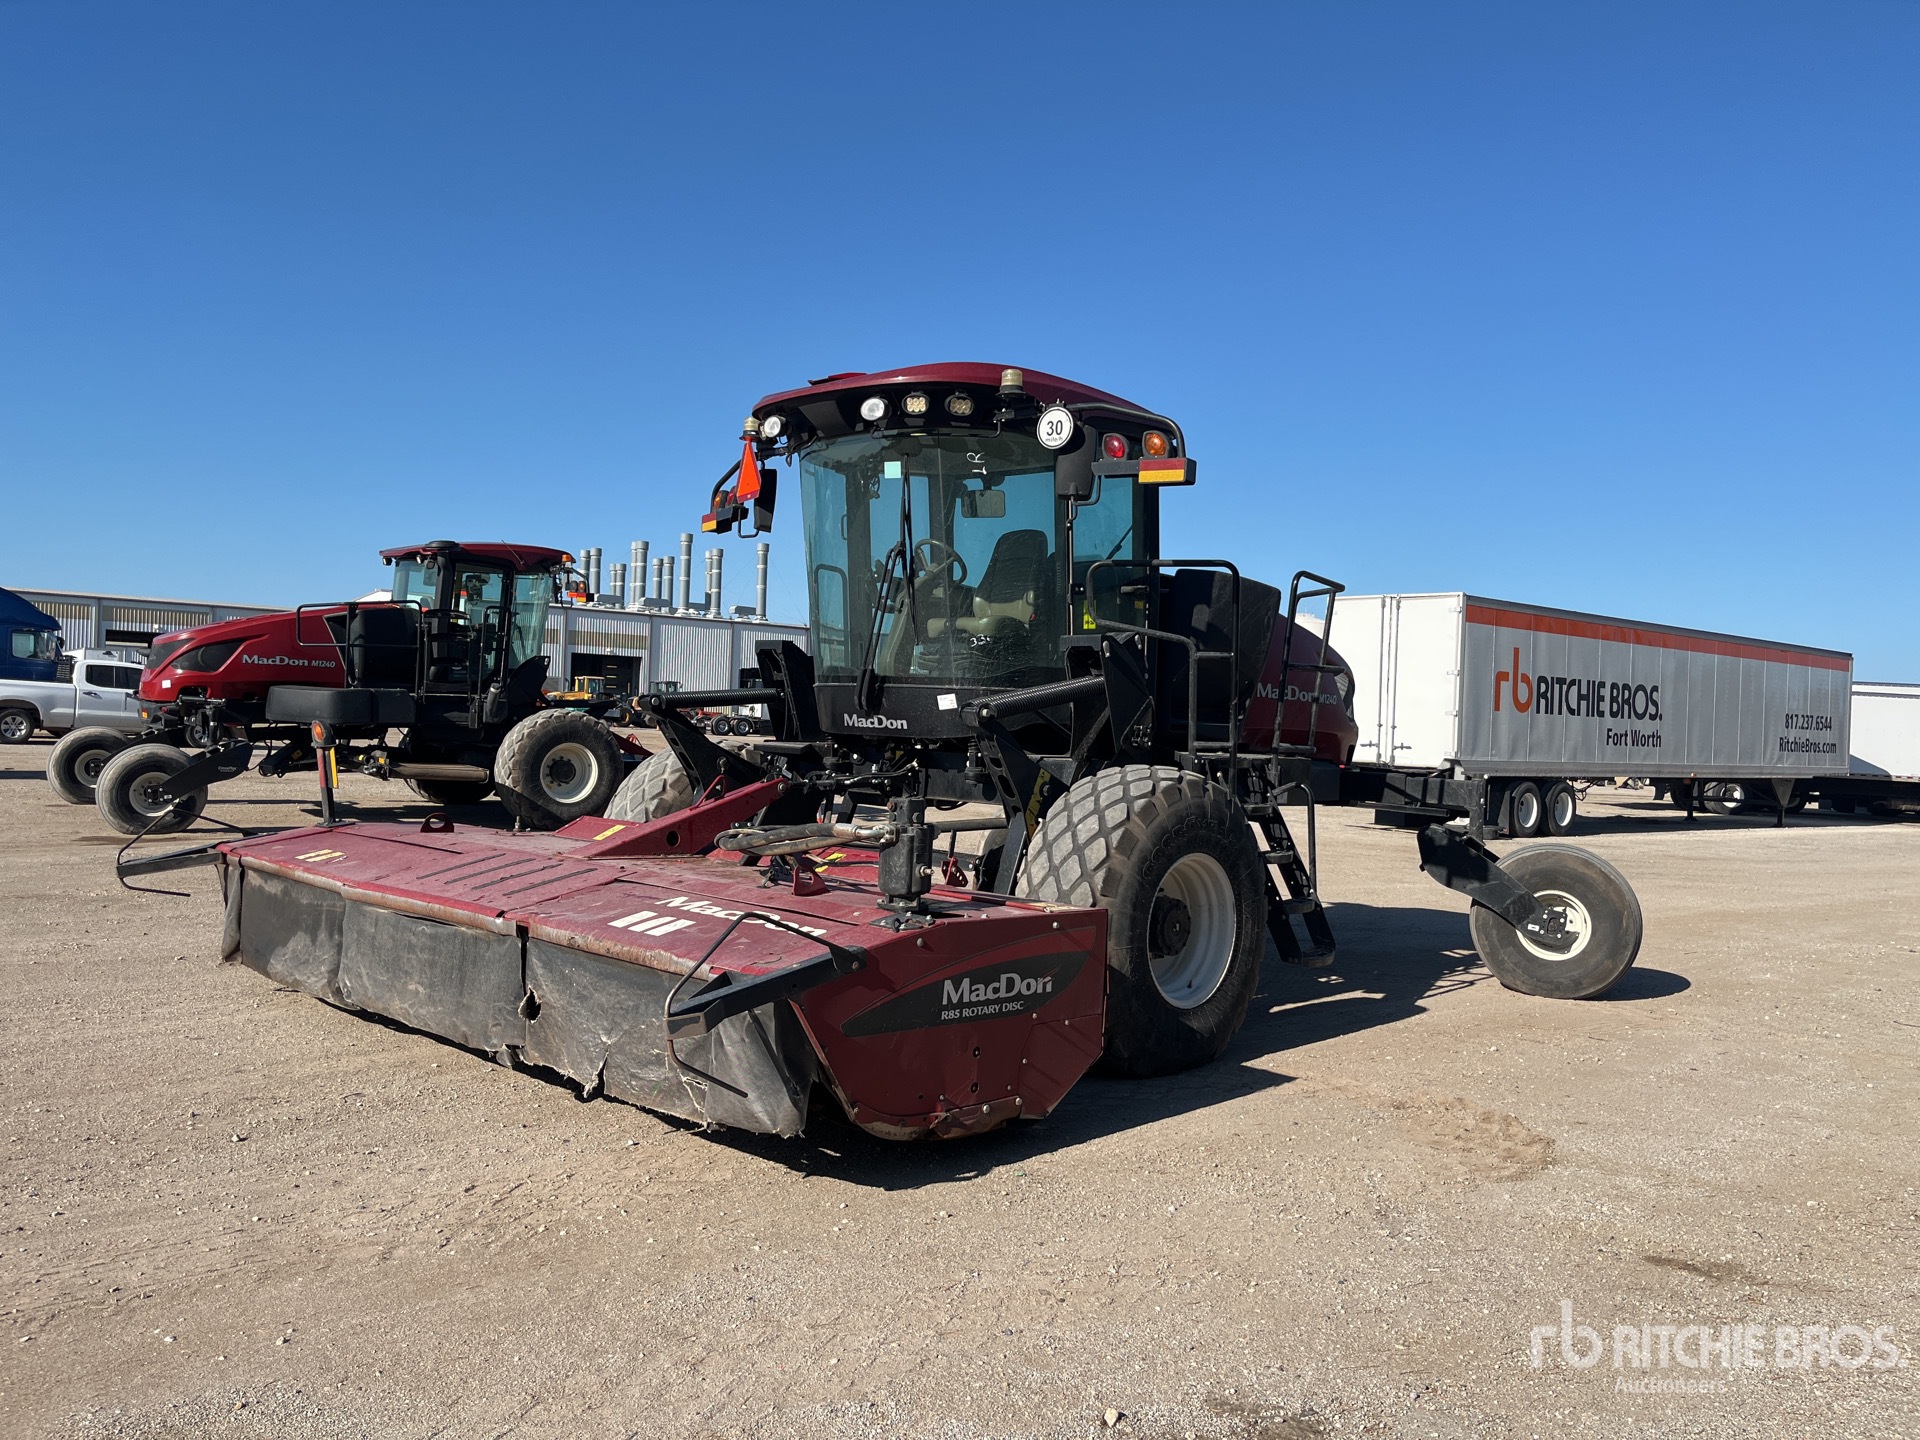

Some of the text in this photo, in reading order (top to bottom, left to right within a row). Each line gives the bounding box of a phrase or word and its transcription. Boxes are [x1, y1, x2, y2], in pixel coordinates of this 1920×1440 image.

[1046, 419, 1063, 437] 30
[242, 654, 336, 668] MacDon M1240
[1494, 646, 1663, 721] rb RITCHIE BROS.
[1319, 693, 1337, 704] M1240
[843, 713, 908, 730] MacDon
[1785, 713, 1832, 731] 817.237.6544
[1606, 728, 1662, 748] Fort Worth
[1779, 736, 1837, 754] RitchieBros.com
[942, 973, 1053, 1005] MacDon
[941, 1000, 1025, 1020] R85 ROTARY DISC
